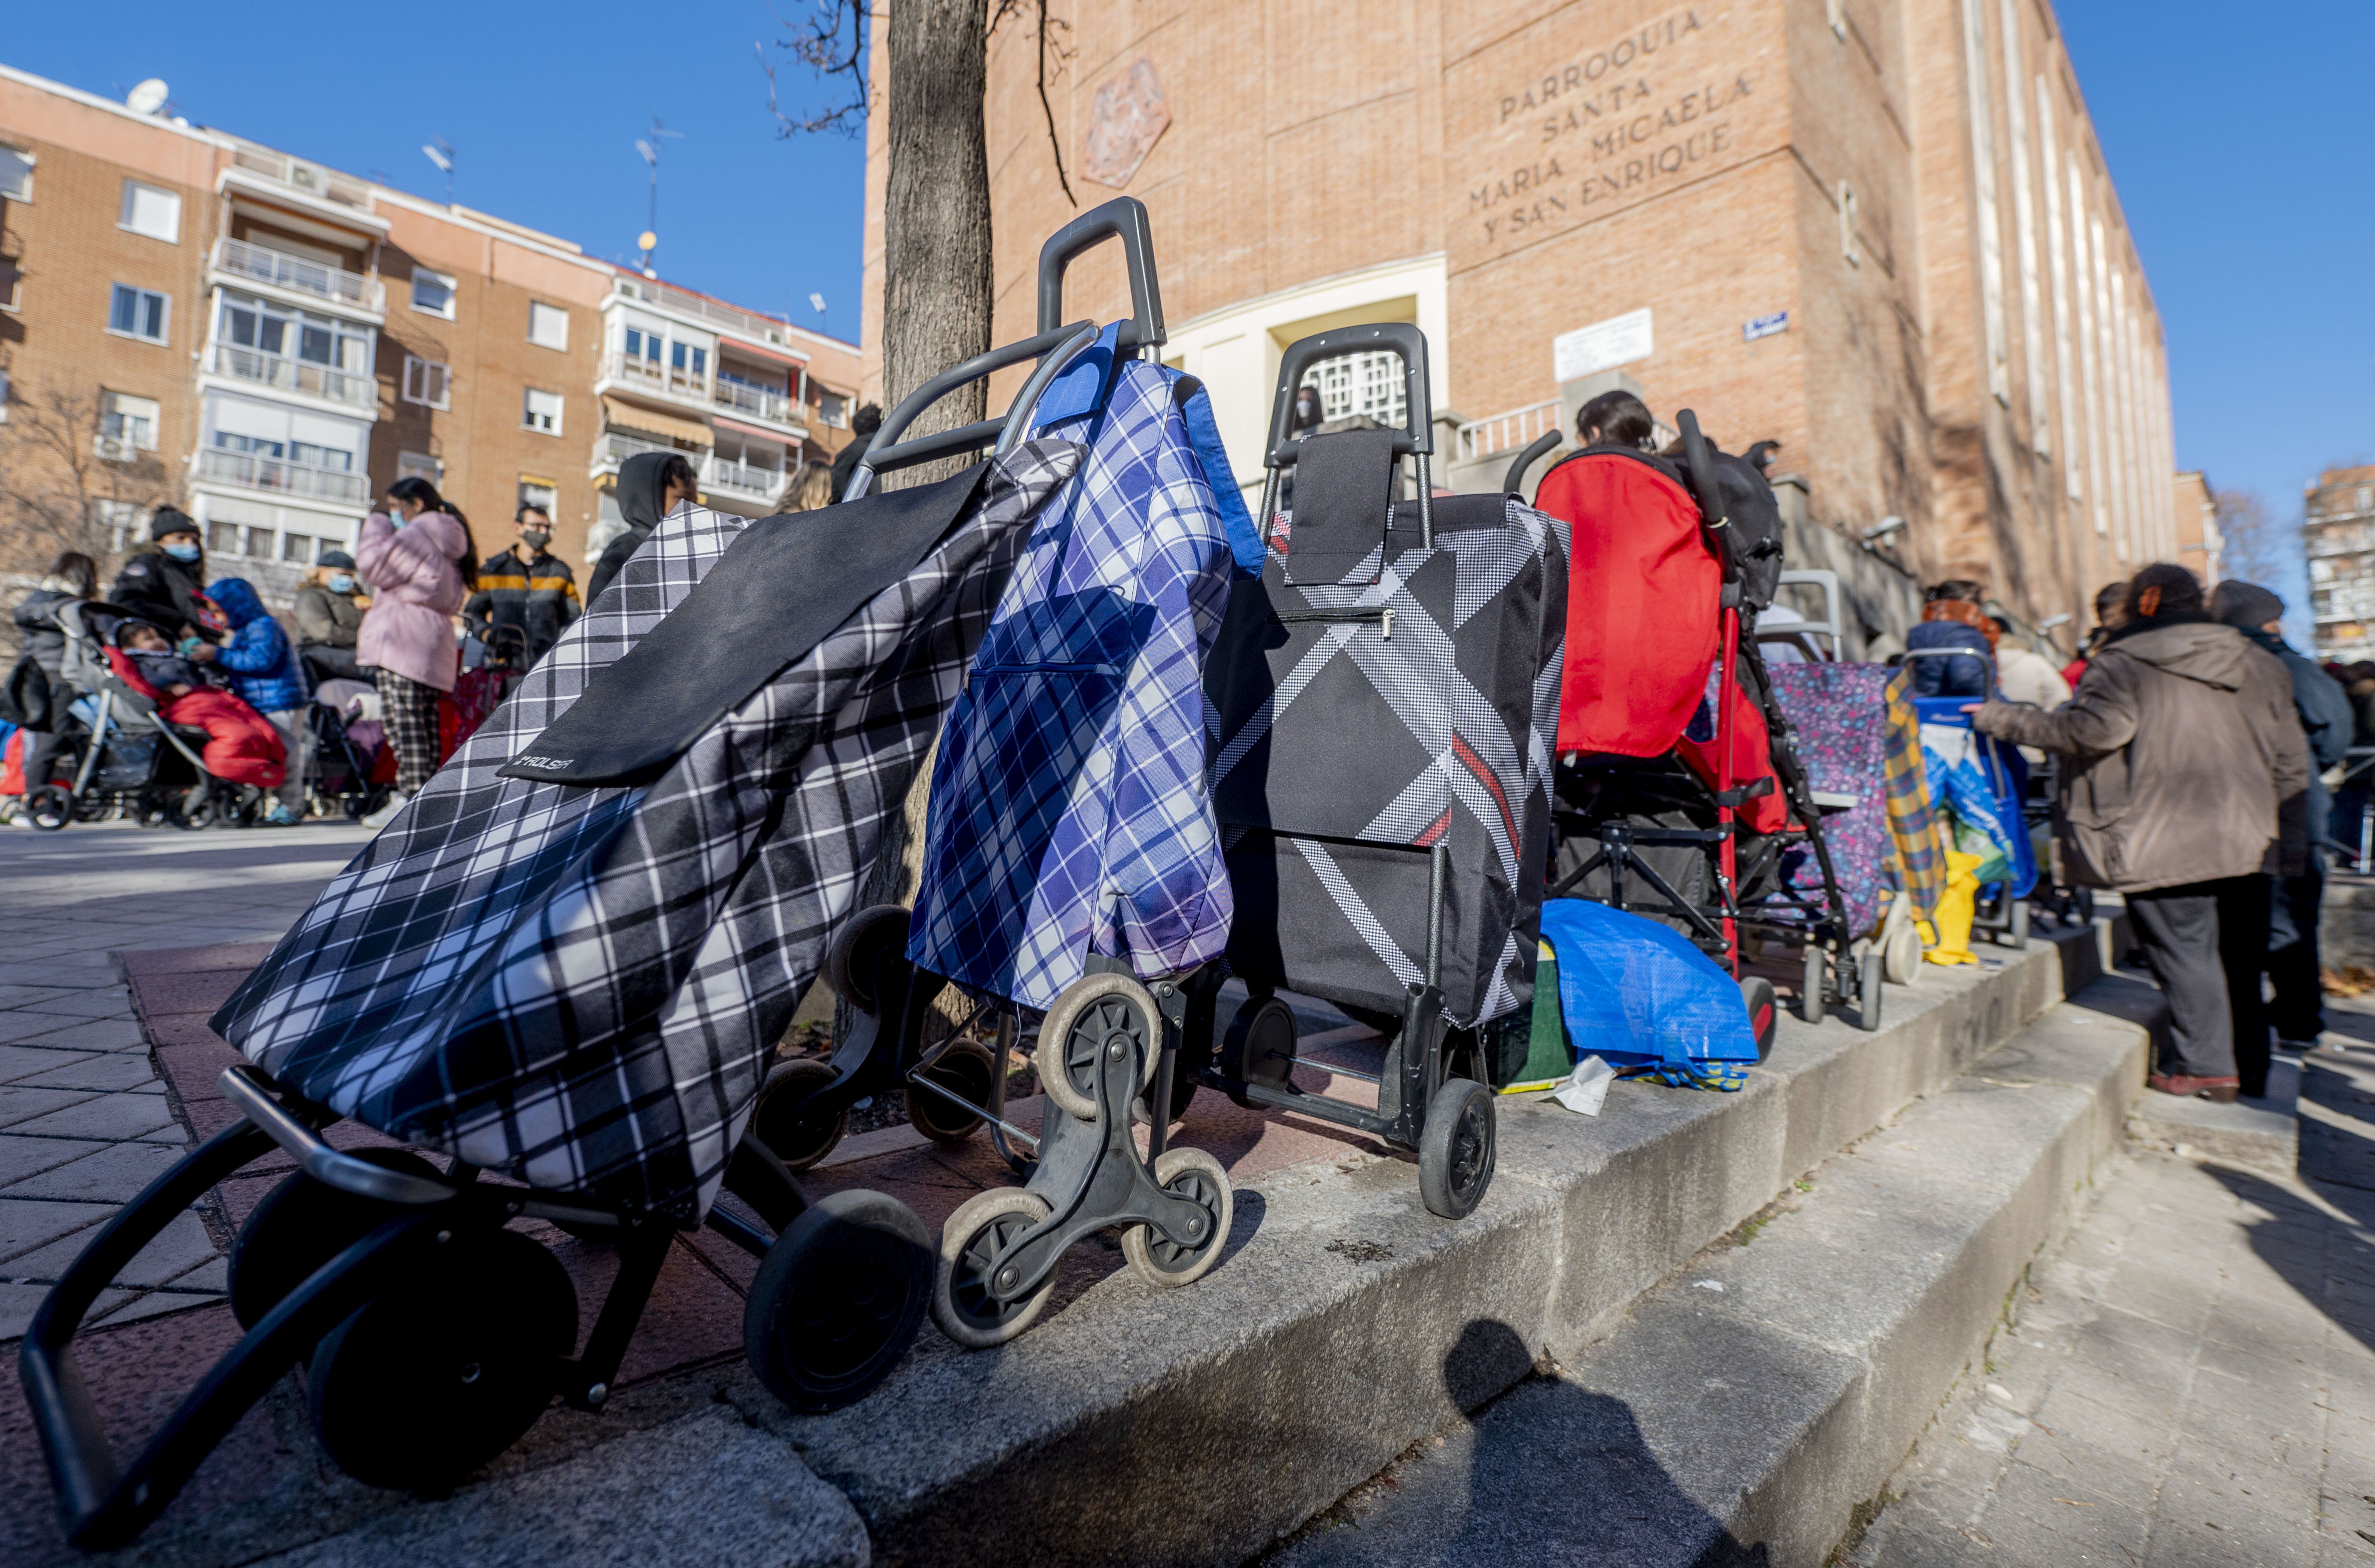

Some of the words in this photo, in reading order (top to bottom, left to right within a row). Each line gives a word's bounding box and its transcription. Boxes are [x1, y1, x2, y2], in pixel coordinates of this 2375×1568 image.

[1500, 10, 1701, 123] PARROQUIA
[1541, 77, 1651, 143] SANTA
[1468, 157, 1563, 214] MARIA
[1592, 75, 1751, 163] MICAELA
[1484, 217, 1499, 243] Y
[1510, 191, 1567, 233] SAN
[1581, 121, 1732, 206] ENRIQUE
